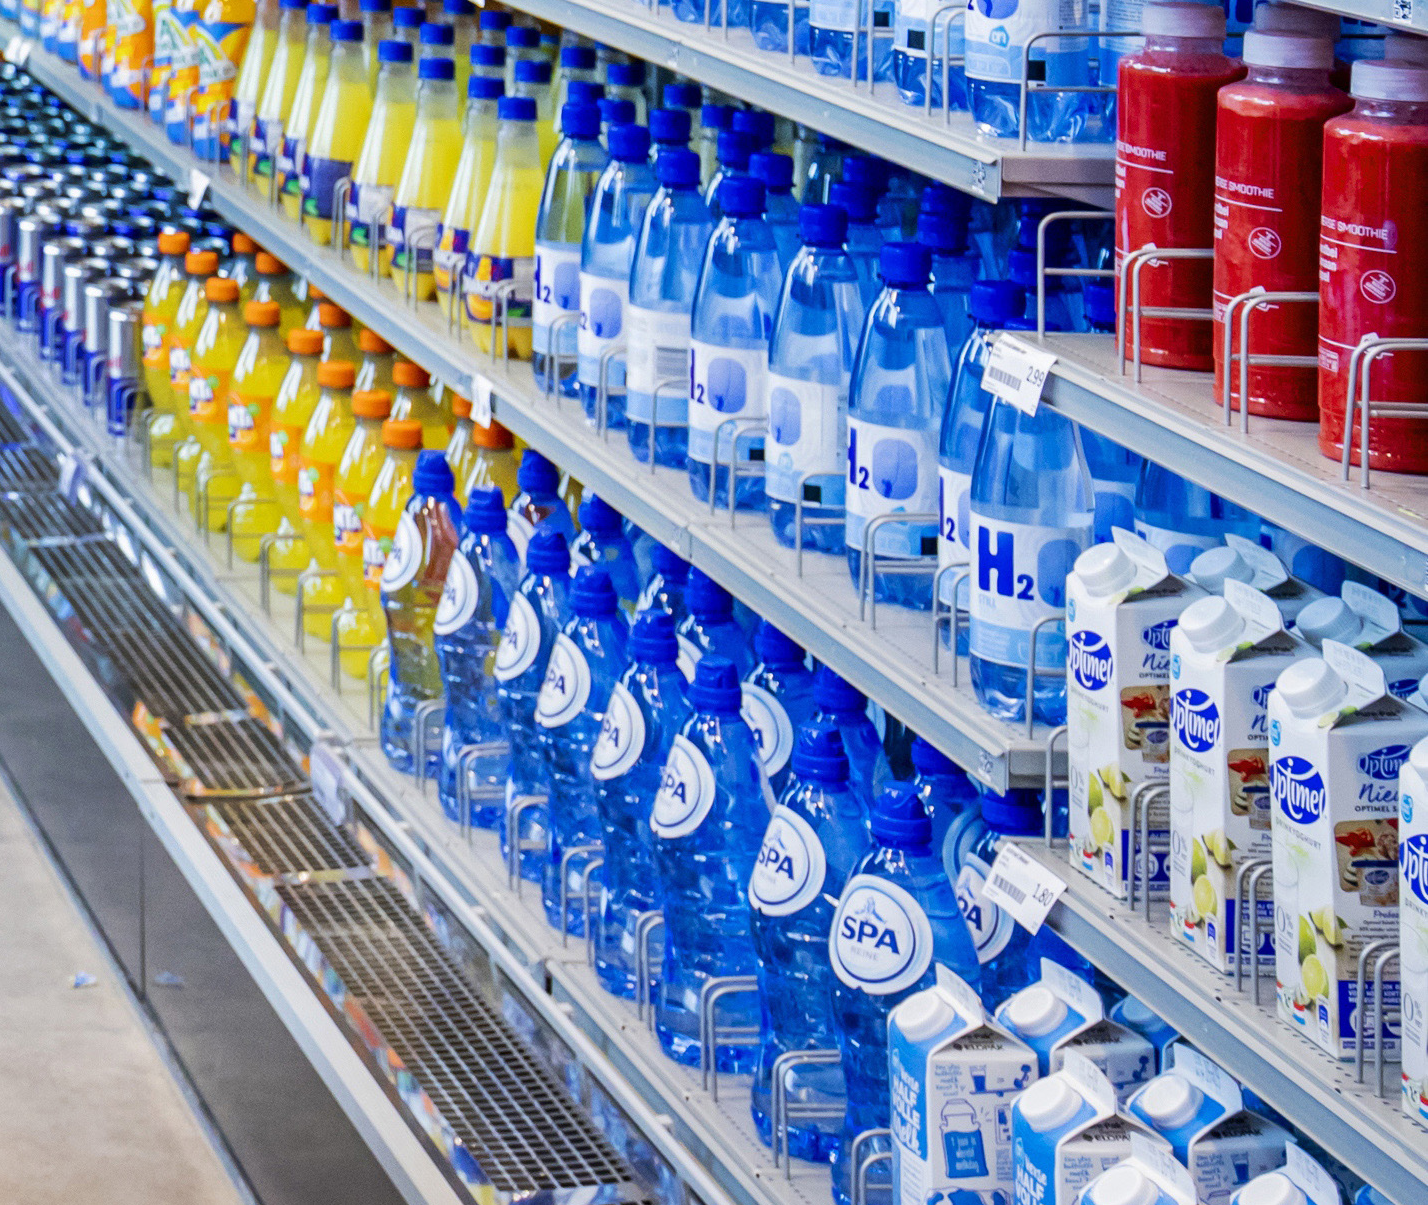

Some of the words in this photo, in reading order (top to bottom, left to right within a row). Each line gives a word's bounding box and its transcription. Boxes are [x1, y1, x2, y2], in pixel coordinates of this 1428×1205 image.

[1126, 144, 1167, 162] SMOOTHIE
[1229, 180, 1274, 199] SMOOTHIE
[1337, 221, 1389, 241] SMOOTHIE
[1026, 365, 1045, 388] 2.99
[1142, 652, 1170, 672] Nie
[547, 670, 566, 695] PA
[603, 720, 620, 748] PA
[1357, 748, 1404, 780] Optim
[1269, 757, 1327, 820] Optimel
[1355, 804, 1392, 813] OPTIMEL
[1032, 882, 1054, 907] 1.80
[841, 915, 901, 956] SPA
[850, 945, 880, 962] REINE
[1094, 1132, 1131, 1142] ELOPA
